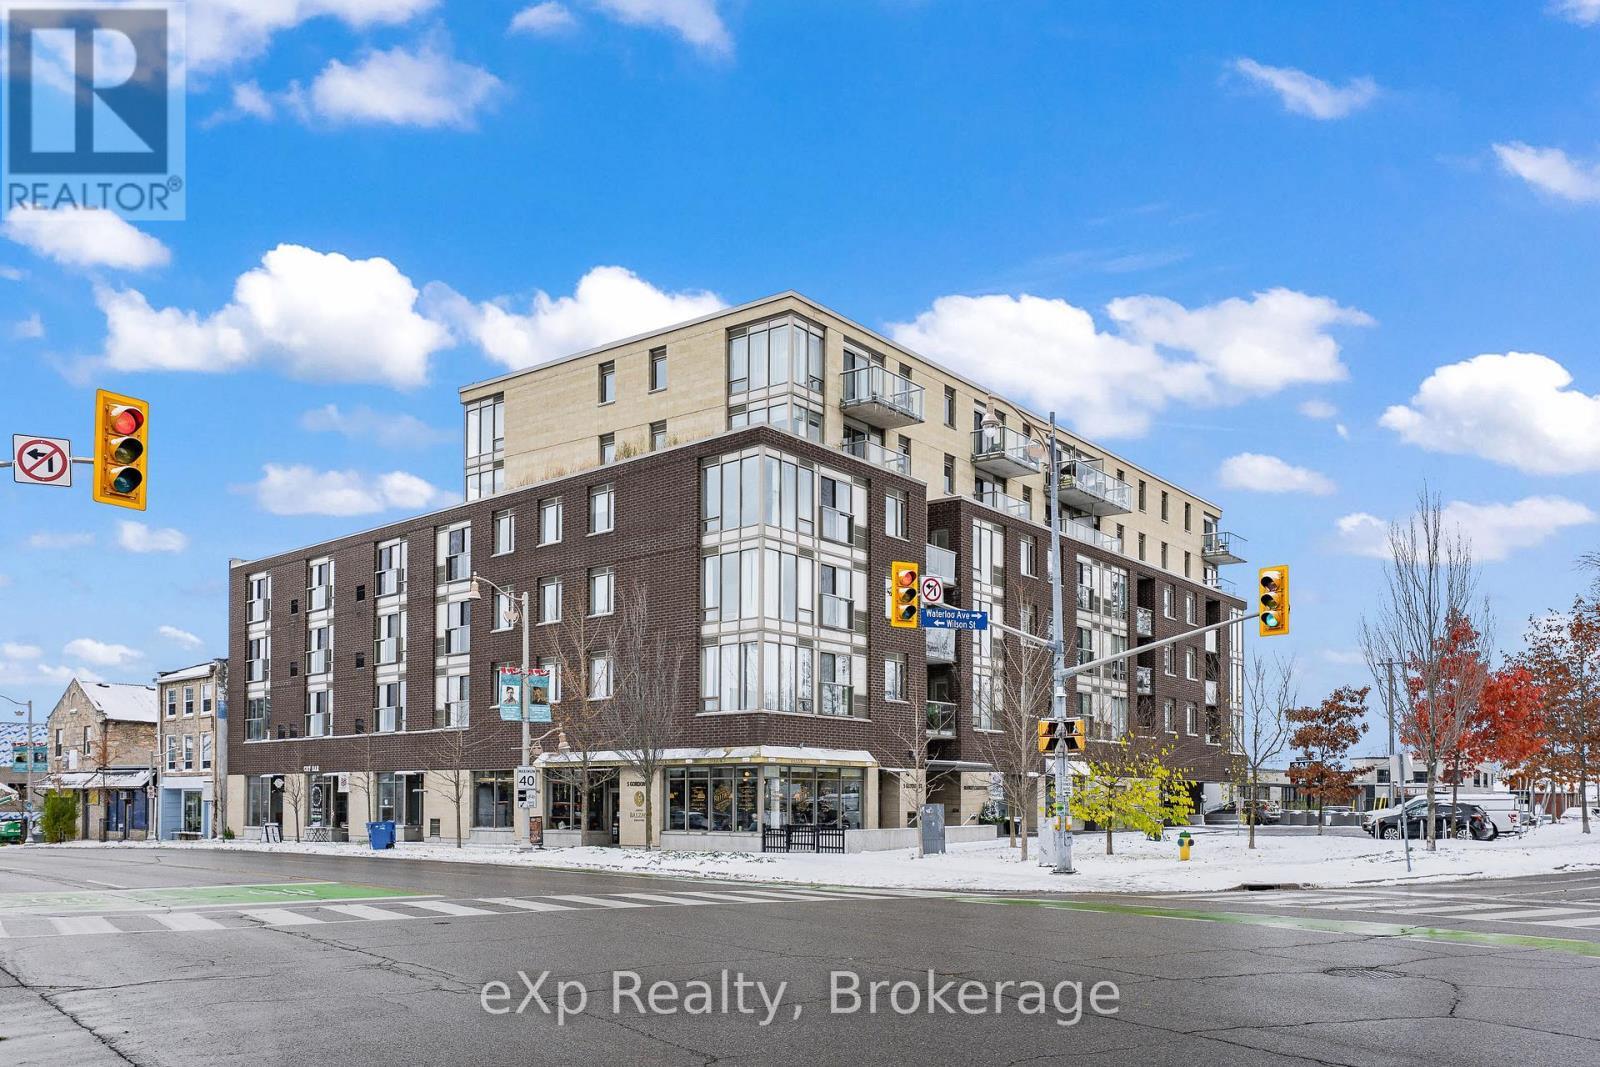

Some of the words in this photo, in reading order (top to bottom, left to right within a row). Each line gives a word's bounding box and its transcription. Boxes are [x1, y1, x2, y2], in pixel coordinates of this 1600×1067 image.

[926, 610, 955, 618] Waterloo
[956, 611, 970, 619] Ave
[946, 620, 968, 628] Wilson
[968, 621, 976, 629] St
[519, 775, 535, 786] 40
